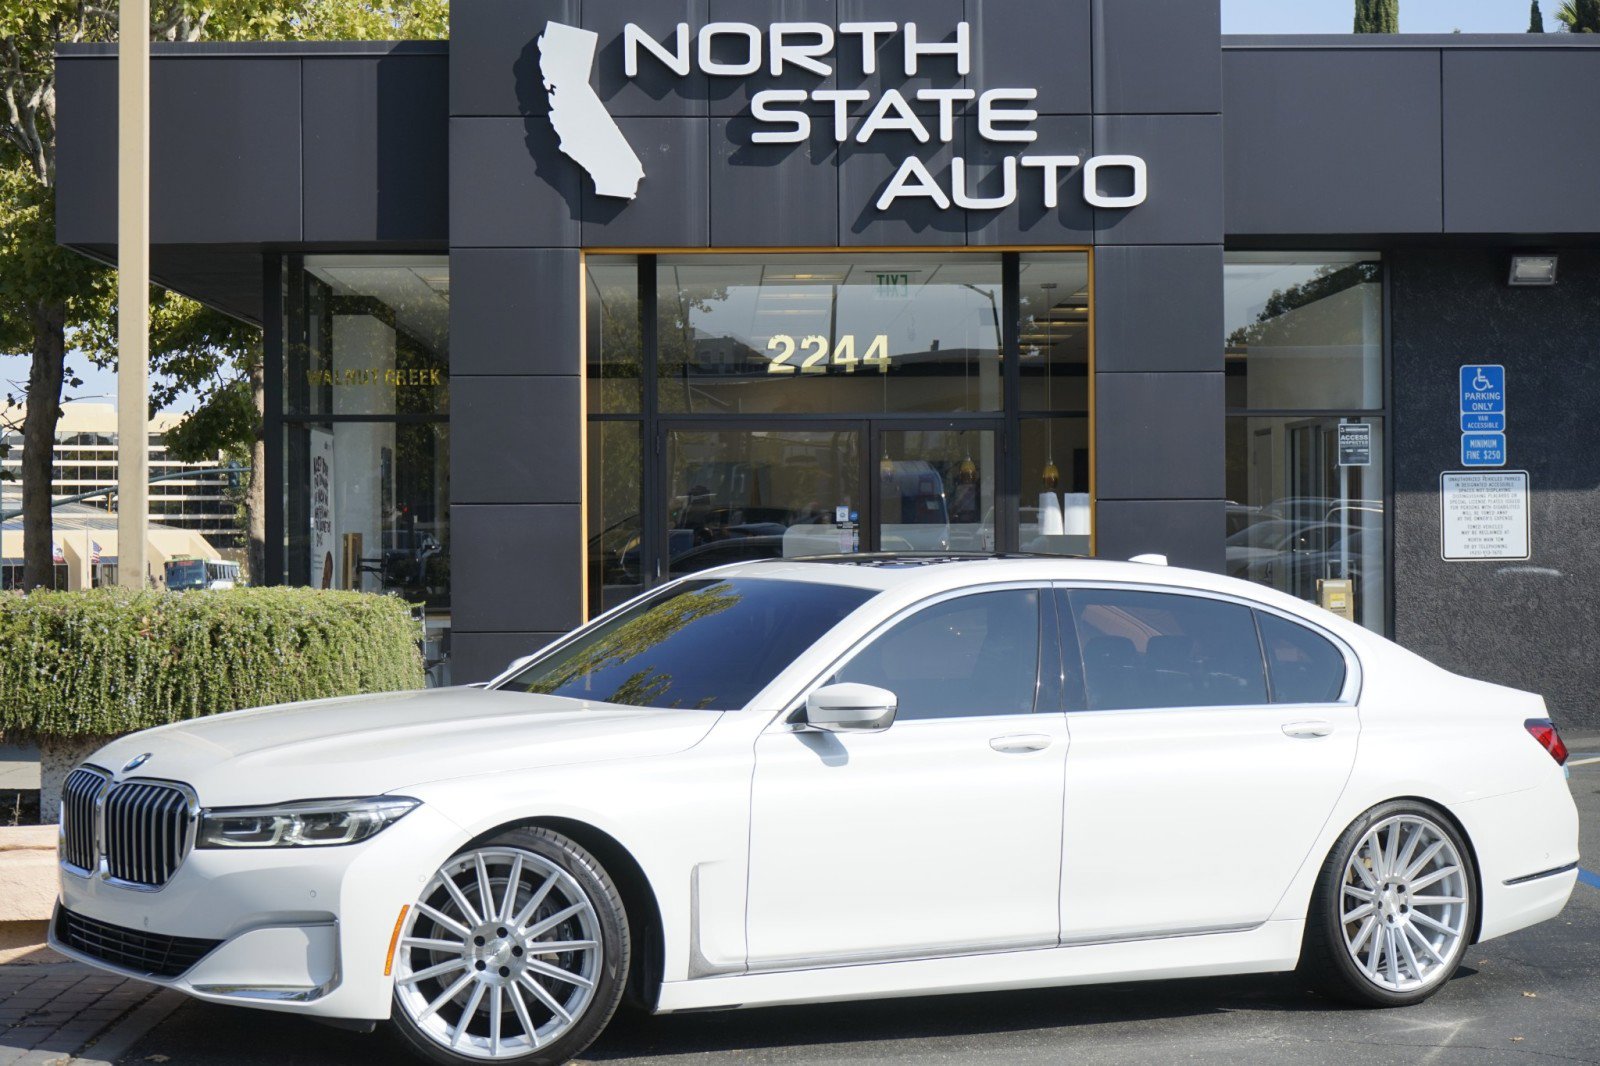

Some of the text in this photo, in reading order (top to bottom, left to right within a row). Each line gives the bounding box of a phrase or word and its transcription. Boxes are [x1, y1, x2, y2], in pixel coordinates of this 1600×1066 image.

[624, 22, 970, 77] NORTH
[751, 88, 1038, 143] STATE
[876, 155, 1147, 210] AUTO
[767, 335, 891, 373] 2244
[306, 369, 440, 386] WALNUT CREEK
[1467, 451, 1501, 459] FINE $250
